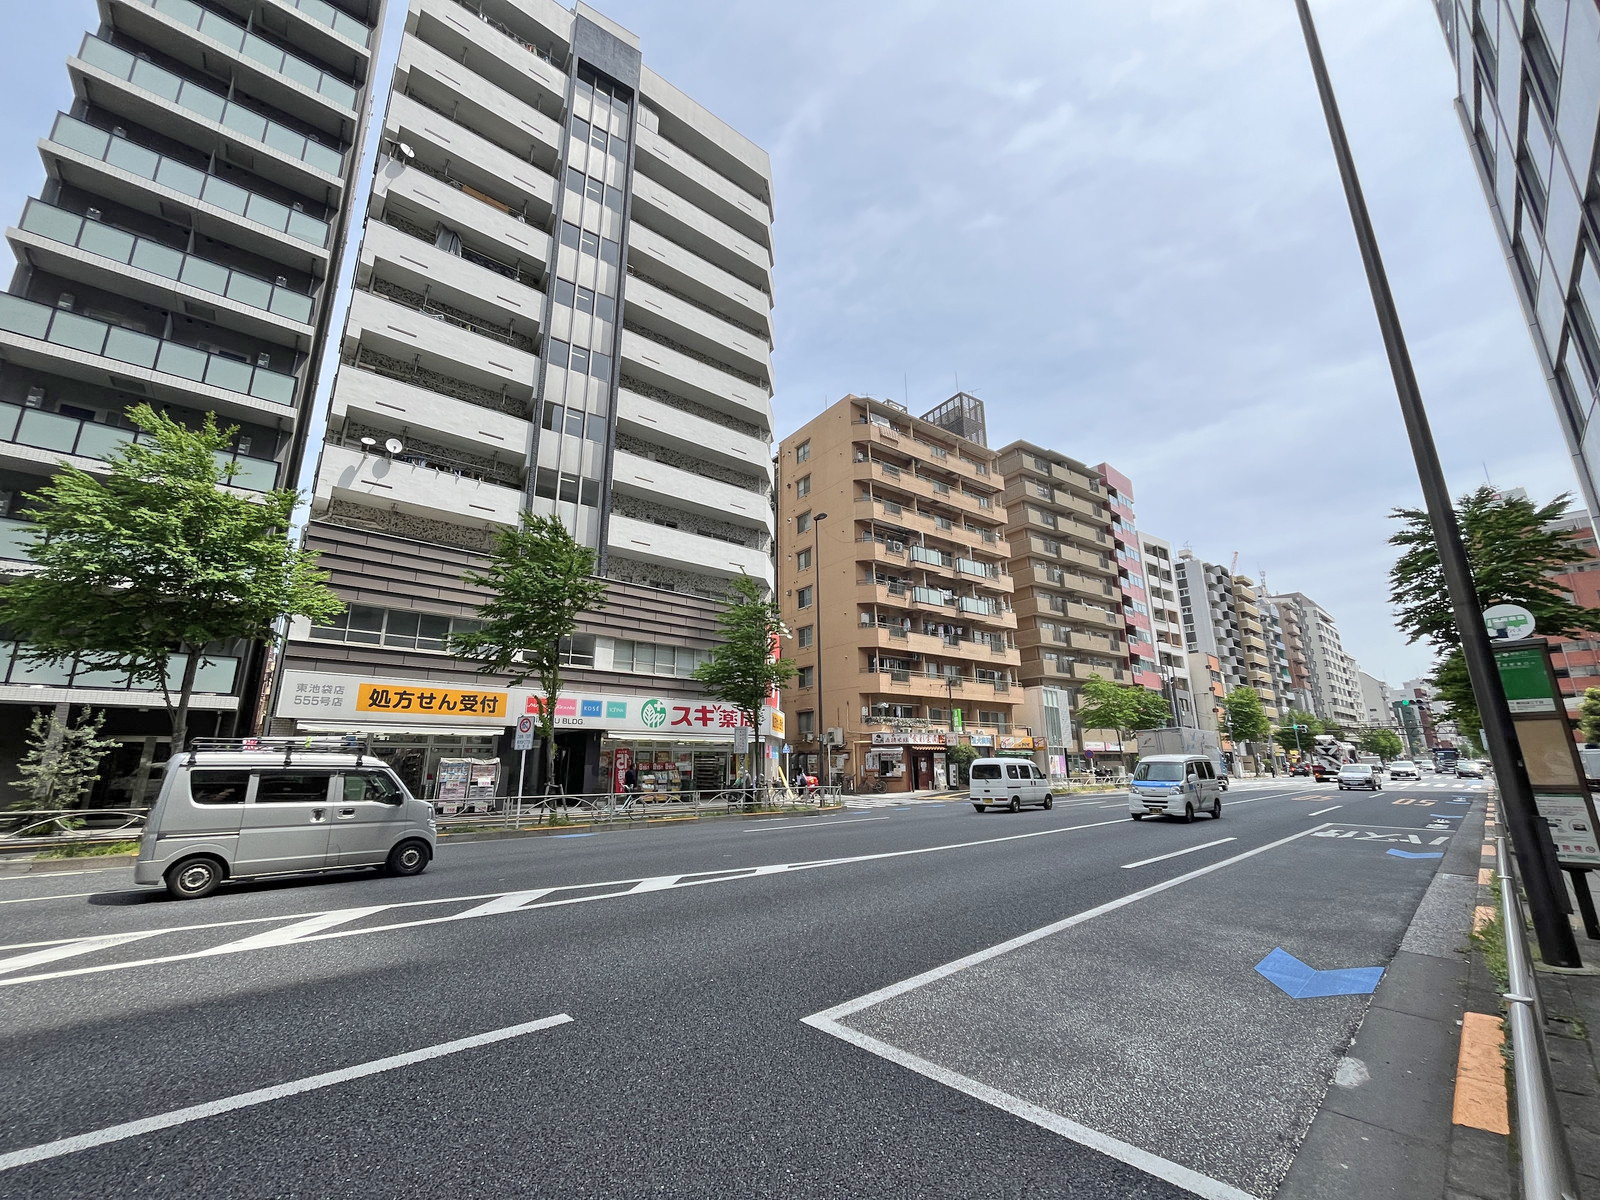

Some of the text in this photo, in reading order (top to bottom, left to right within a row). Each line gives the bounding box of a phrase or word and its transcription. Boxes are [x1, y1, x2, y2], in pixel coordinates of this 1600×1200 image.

[296, 683, 345, 695] 東池袋店
[294, 695, 343, 707] 555号店
[368, 688, 499, 714] 処方せん受付
